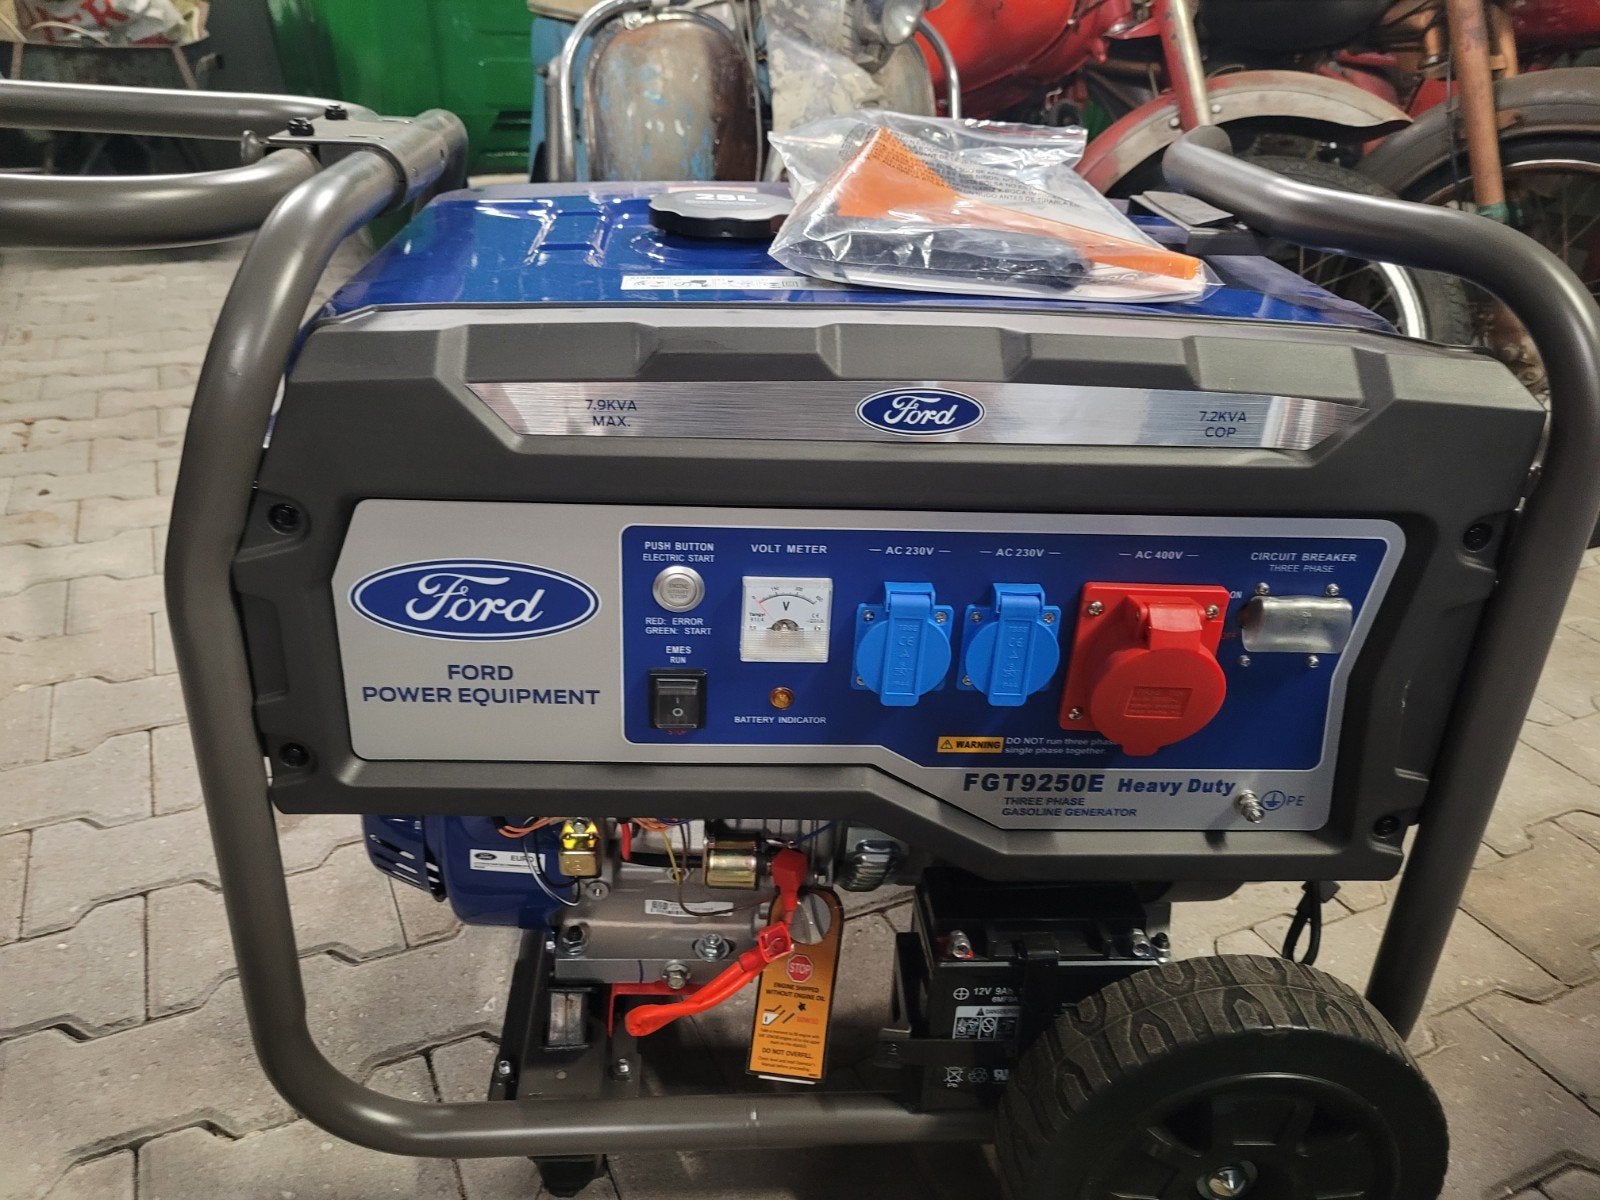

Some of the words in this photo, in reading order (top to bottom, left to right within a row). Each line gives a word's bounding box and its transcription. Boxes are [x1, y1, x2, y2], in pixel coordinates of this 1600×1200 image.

[585, 399, 638, 411] 7.9KVA
[883, 395, 960, 427] Ford
[592, 416, 631, 427] MAX.
[1199, 411, 1248, 422] 7.2KVA
[1205, 427, 1237, 438] COP
[644, 541, 671, 551] PUSH
[675, 542, 715, 552] BUTTON
[750, 544, 781, 553] VOLT
[786, 544, 828, 554] METER
[885, 546, 903, 555] AC
[905, 546, 935, 556] 230V
[996, 548, 1013, 557] AC
[1015, 548, 1045, 557] 230V
[1135, 550, 1153, 559] AC
[1154, 551, 1184, 560] 400V
[1250, 552, 1297, 562] CIRCUIT
[1301, 552, 1358, 563] BREAKER
[643, 553, 684, 562] ELECTRIC
[688, 554, 715, 563] START
[1269, 564, 1300, 572] THREE
[1303, 564, 1335, 573] PHASE
[405, 572, 547, 622] Ford
[1229, 590, 1243, 599] ON
[782, 601, 790, 611] V
[645, 617, 667, 625] RED:
[672, 617, 704, 626] ERROR
[645, 627, 679, 635] GREEN:
[684, 627, 712, 636] START
[666, 646, 692, 655] EMES
[670, 656, 687, 664] RUN
[447, 664, 514, 681] FORD
[362, 686, 452, 703] POWER
[458, 687, 601, 706] EQUIPMENT
[734, 715, 775, 724] BATTERY
[778, 716, 827, 724] INDICATOR
[956, 740, 1001, 750] WARNING
[1006, 737, 1021, 745] DO
[1024, 737, 1045, 745] NOT
[1005, 747, 1034, 755] single
[1035, 747, 1064, 755] phase
[1065, 747, 1106, 756] together
[963, 773, 1106, 793] FGT9250E
[1117, 778, 1183, 796] Heavy
[1187, 778, 1236, 796] Duty
[1003, 797, 1043, 806] THREE
[1046, 797, 1085, 806] PHASE
[1285, 795, 1305, 807] PE
[1002, 808, 1062, 816] GASOLINE
[1065, 808, 1137, 817] GENERATOR
[789, 963, 812, 974] STOP
[773, 982, 795, 990] ENGINE
[766, 989, 792, 997] WITHOUT
[793, 993, 815, 1001] ENGINE
[973, 987, 992, 996] 12V
